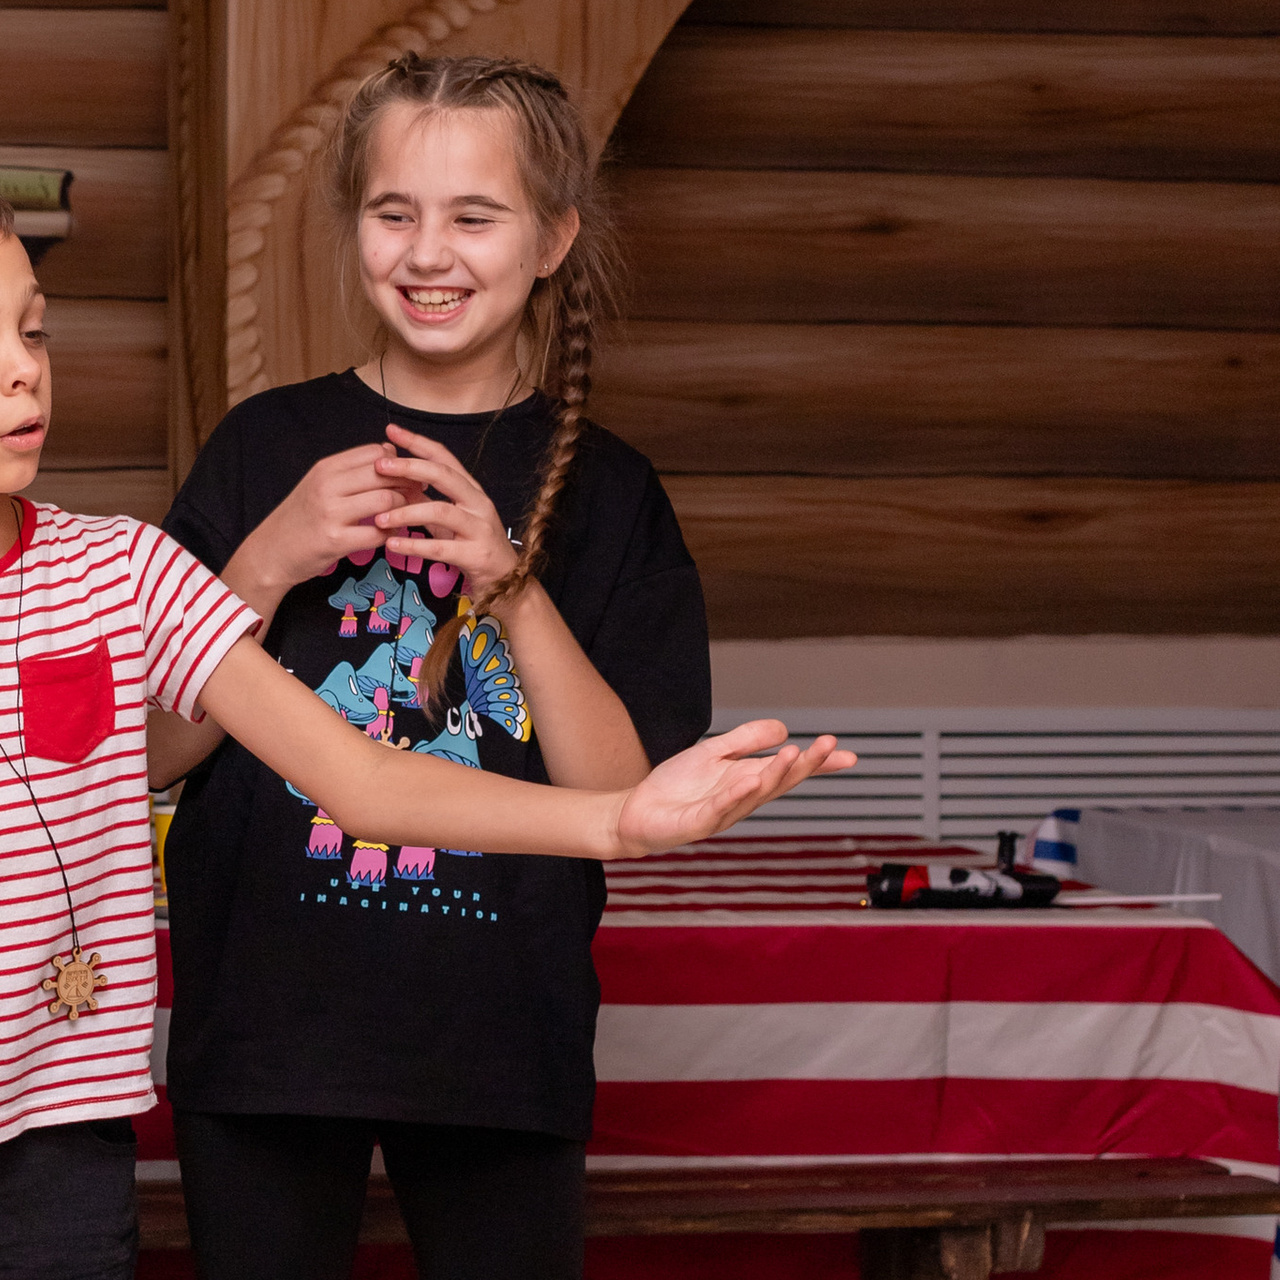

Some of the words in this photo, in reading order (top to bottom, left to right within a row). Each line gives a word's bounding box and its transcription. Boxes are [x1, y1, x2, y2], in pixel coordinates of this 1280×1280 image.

[330, 878, 380, 892] USE
[412, 886, 480, 901] YOUR
[300, 893, 497, 921] IMAGINATION
